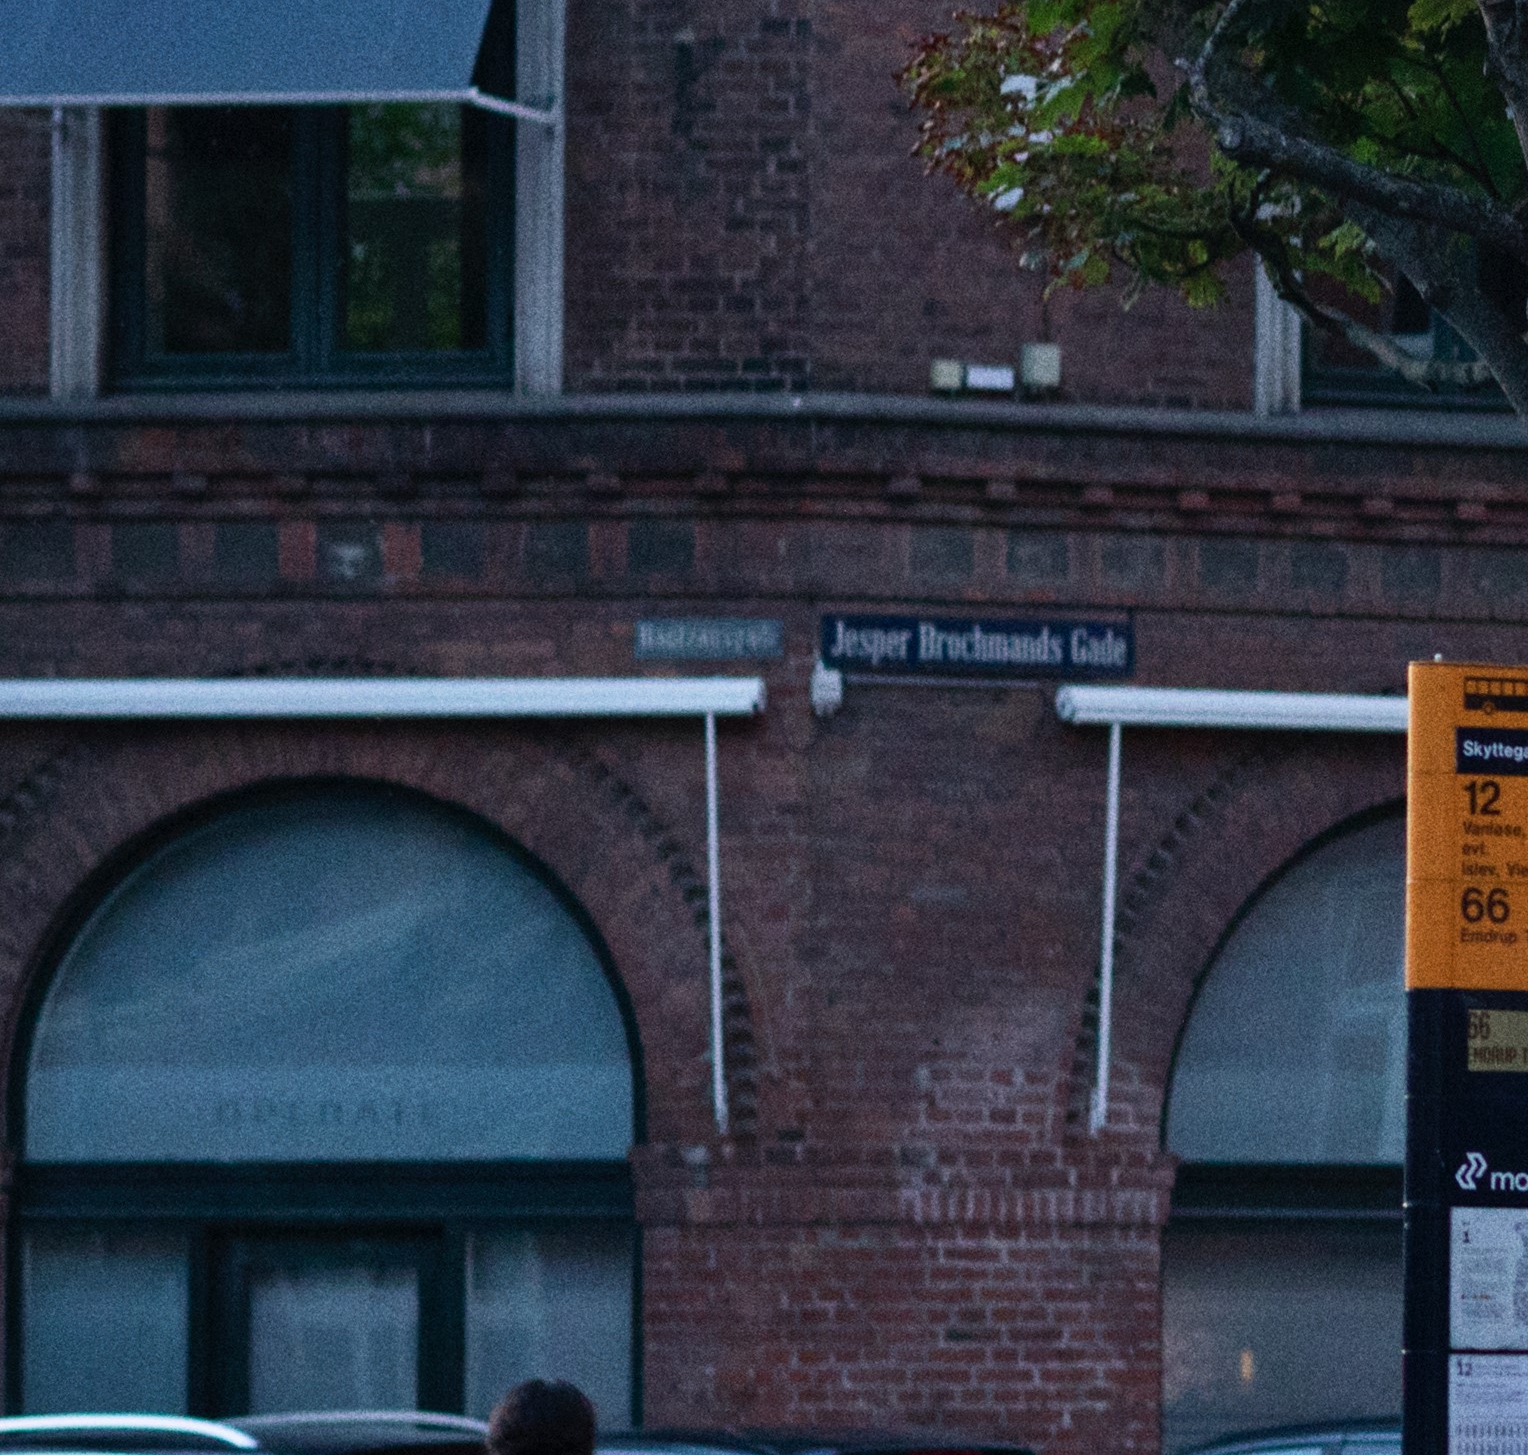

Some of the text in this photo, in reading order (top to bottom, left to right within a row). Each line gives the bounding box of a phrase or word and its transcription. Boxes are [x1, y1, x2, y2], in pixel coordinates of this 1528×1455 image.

[832, 620, 912, 666] Jesper
[1071, 626, 1127, 666] Gade
[1464, 780, 1501, 815] 12
[1461, 887, 1510, 924] 66
[1469, 1046, 1517, 1064] MDRUP
